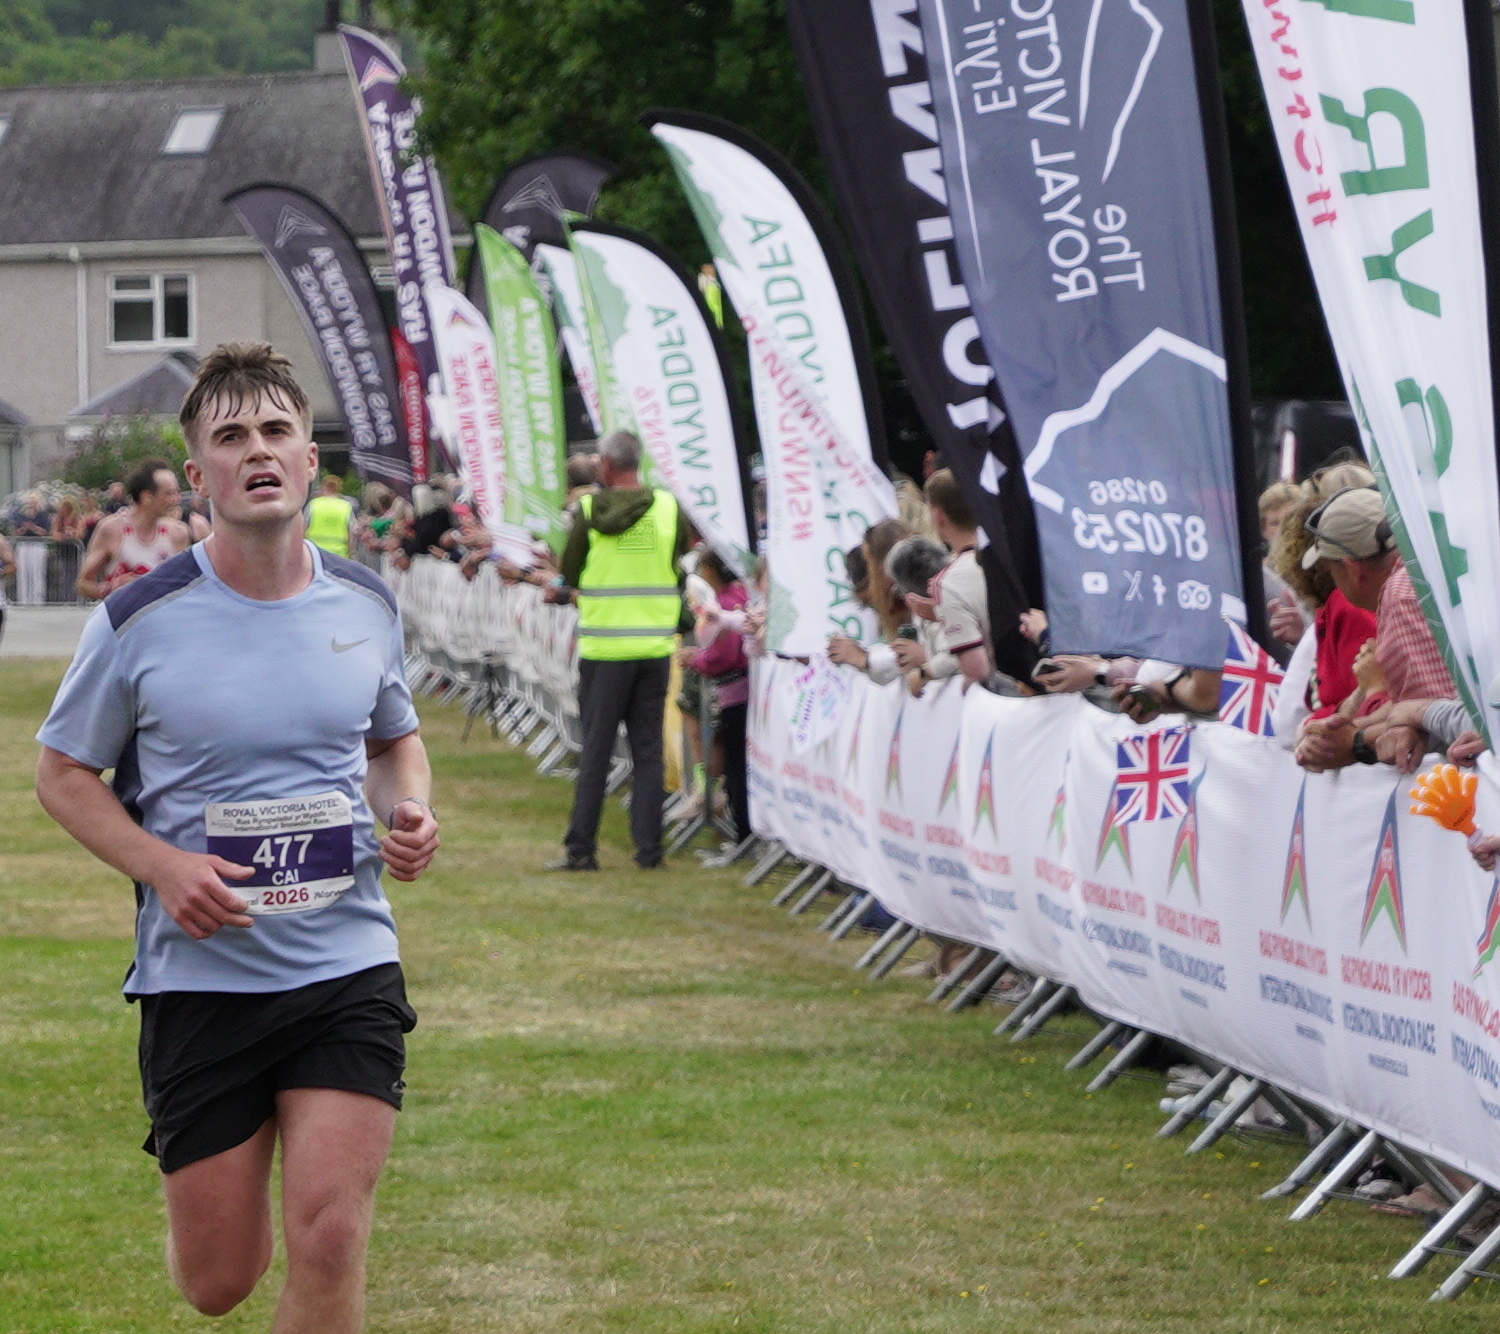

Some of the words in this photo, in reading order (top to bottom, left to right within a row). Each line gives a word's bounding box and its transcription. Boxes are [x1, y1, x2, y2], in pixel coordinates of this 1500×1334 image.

[223, 808, 258, 818] ROYAL
[259, 803, 306, 815] VICTORIA
[308, 798, 338, 811] HOTEL
[252, 834, 314, 868] 477
[272, 869, 300, 885] CAI
[263, 887, 309, 905] 2026
